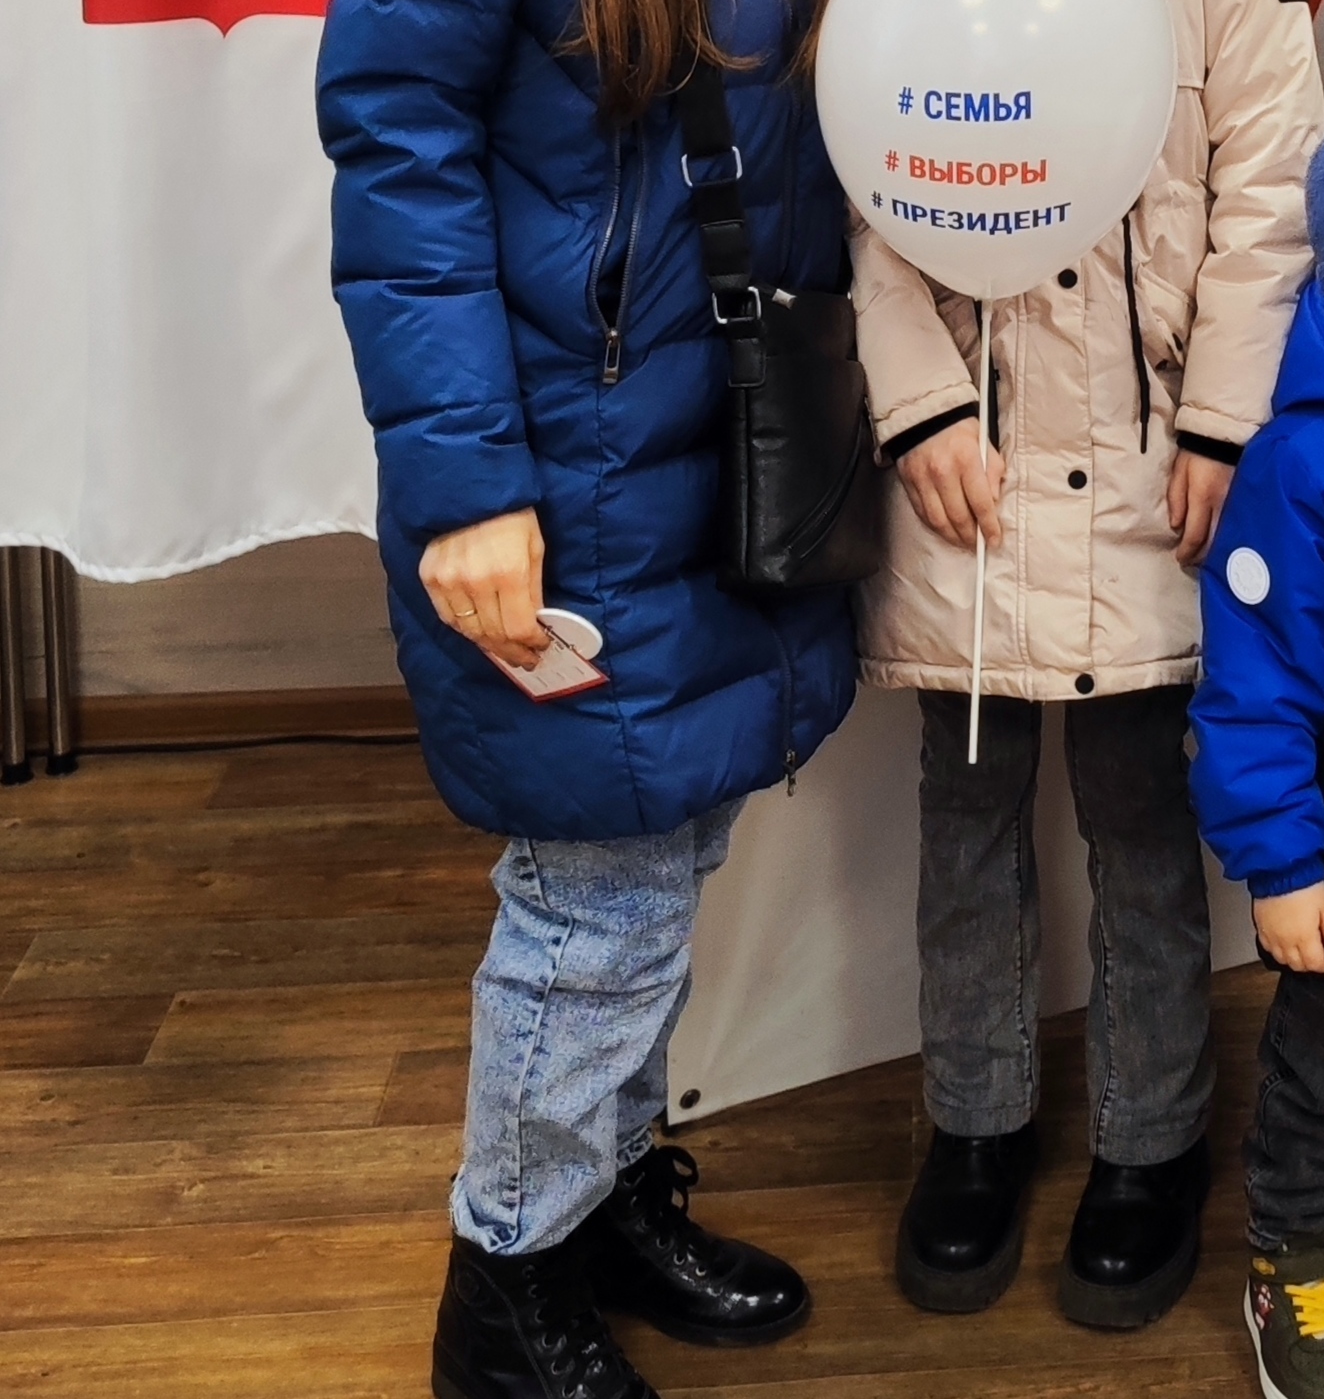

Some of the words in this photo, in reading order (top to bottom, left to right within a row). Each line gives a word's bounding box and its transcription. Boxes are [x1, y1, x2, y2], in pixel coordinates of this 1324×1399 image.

[923, 90, 1032, 123] СЕМЬЯ
[909, 155, 1047, 186] ВЫБОРЫ
[891, 198, 1071, 235] ПРЕЗИДЕНТ
